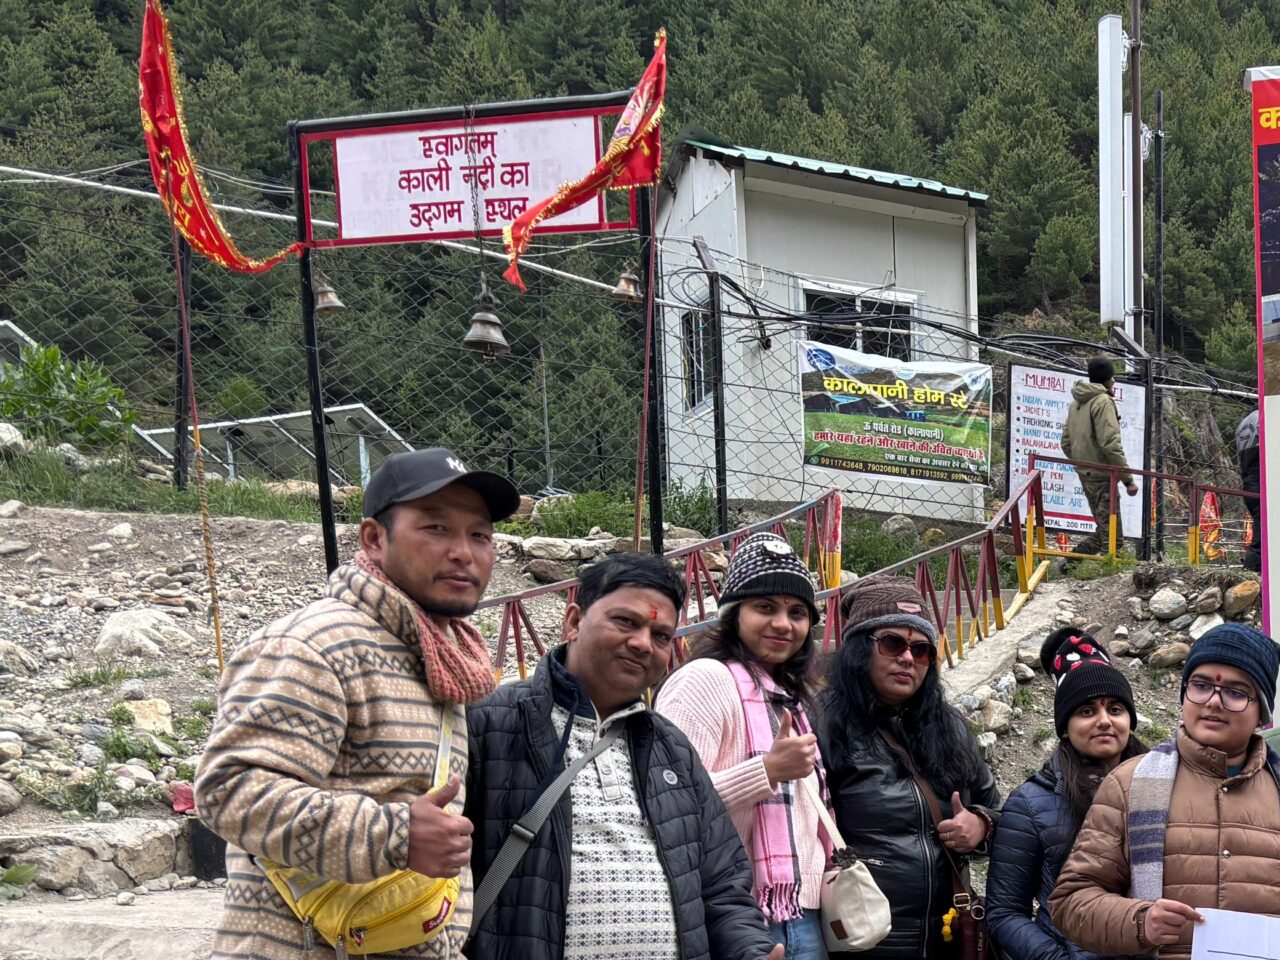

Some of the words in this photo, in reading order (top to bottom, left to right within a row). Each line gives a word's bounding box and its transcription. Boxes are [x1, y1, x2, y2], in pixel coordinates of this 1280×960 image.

[398, 157, 452, 193] काली
[500, 161, 531, 188] का
[409, 200, 464, 231] उद्गम
[823, 375, 908, 401] कालापानी
[912, 383, 946, 405] होम
[949, 389, 969, 410] स्टे
[1025, 373, 1066, 391] MUMBAI
[812, 427, 834, 442] हमारे
[855, 431, 875, 446] रहने
[876, 434, 895, 449] और
[895, 437, 917, 452] खाने
[917, 439, 931, 454] की
[1066, 520, 1078, 528] 200
